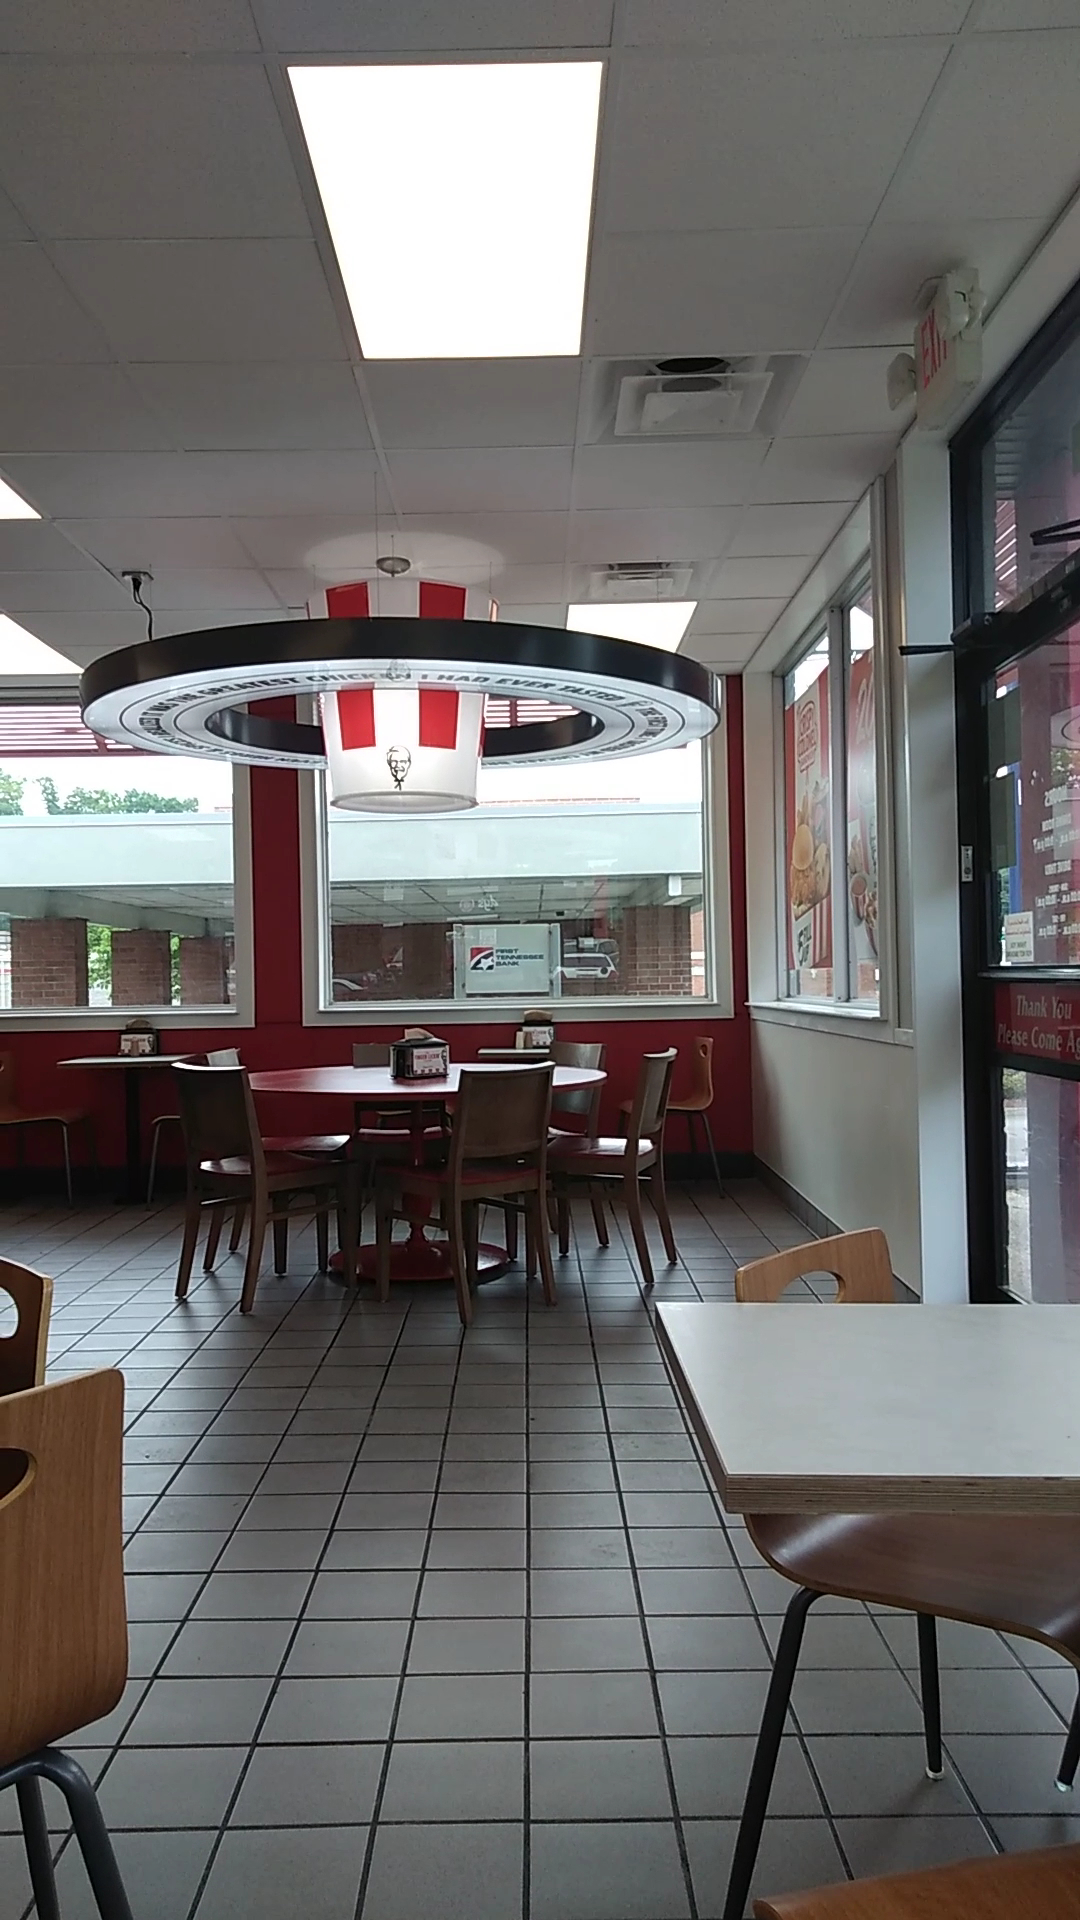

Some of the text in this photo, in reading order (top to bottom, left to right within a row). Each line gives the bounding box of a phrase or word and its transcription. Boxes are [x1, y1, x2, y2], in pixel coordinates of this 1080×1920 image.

[198, 676, 301, 697] GREATEST
[437, 673, 490, 684] HAD
[494, 677, 556, 690] EVER
[557, 684, 627, 702] TASTED
[1016, 994, 1073, 1020] Thank You
[997, 1023, 1029, 1047] Please
[1031, 1026, 1063, 1051] Come
